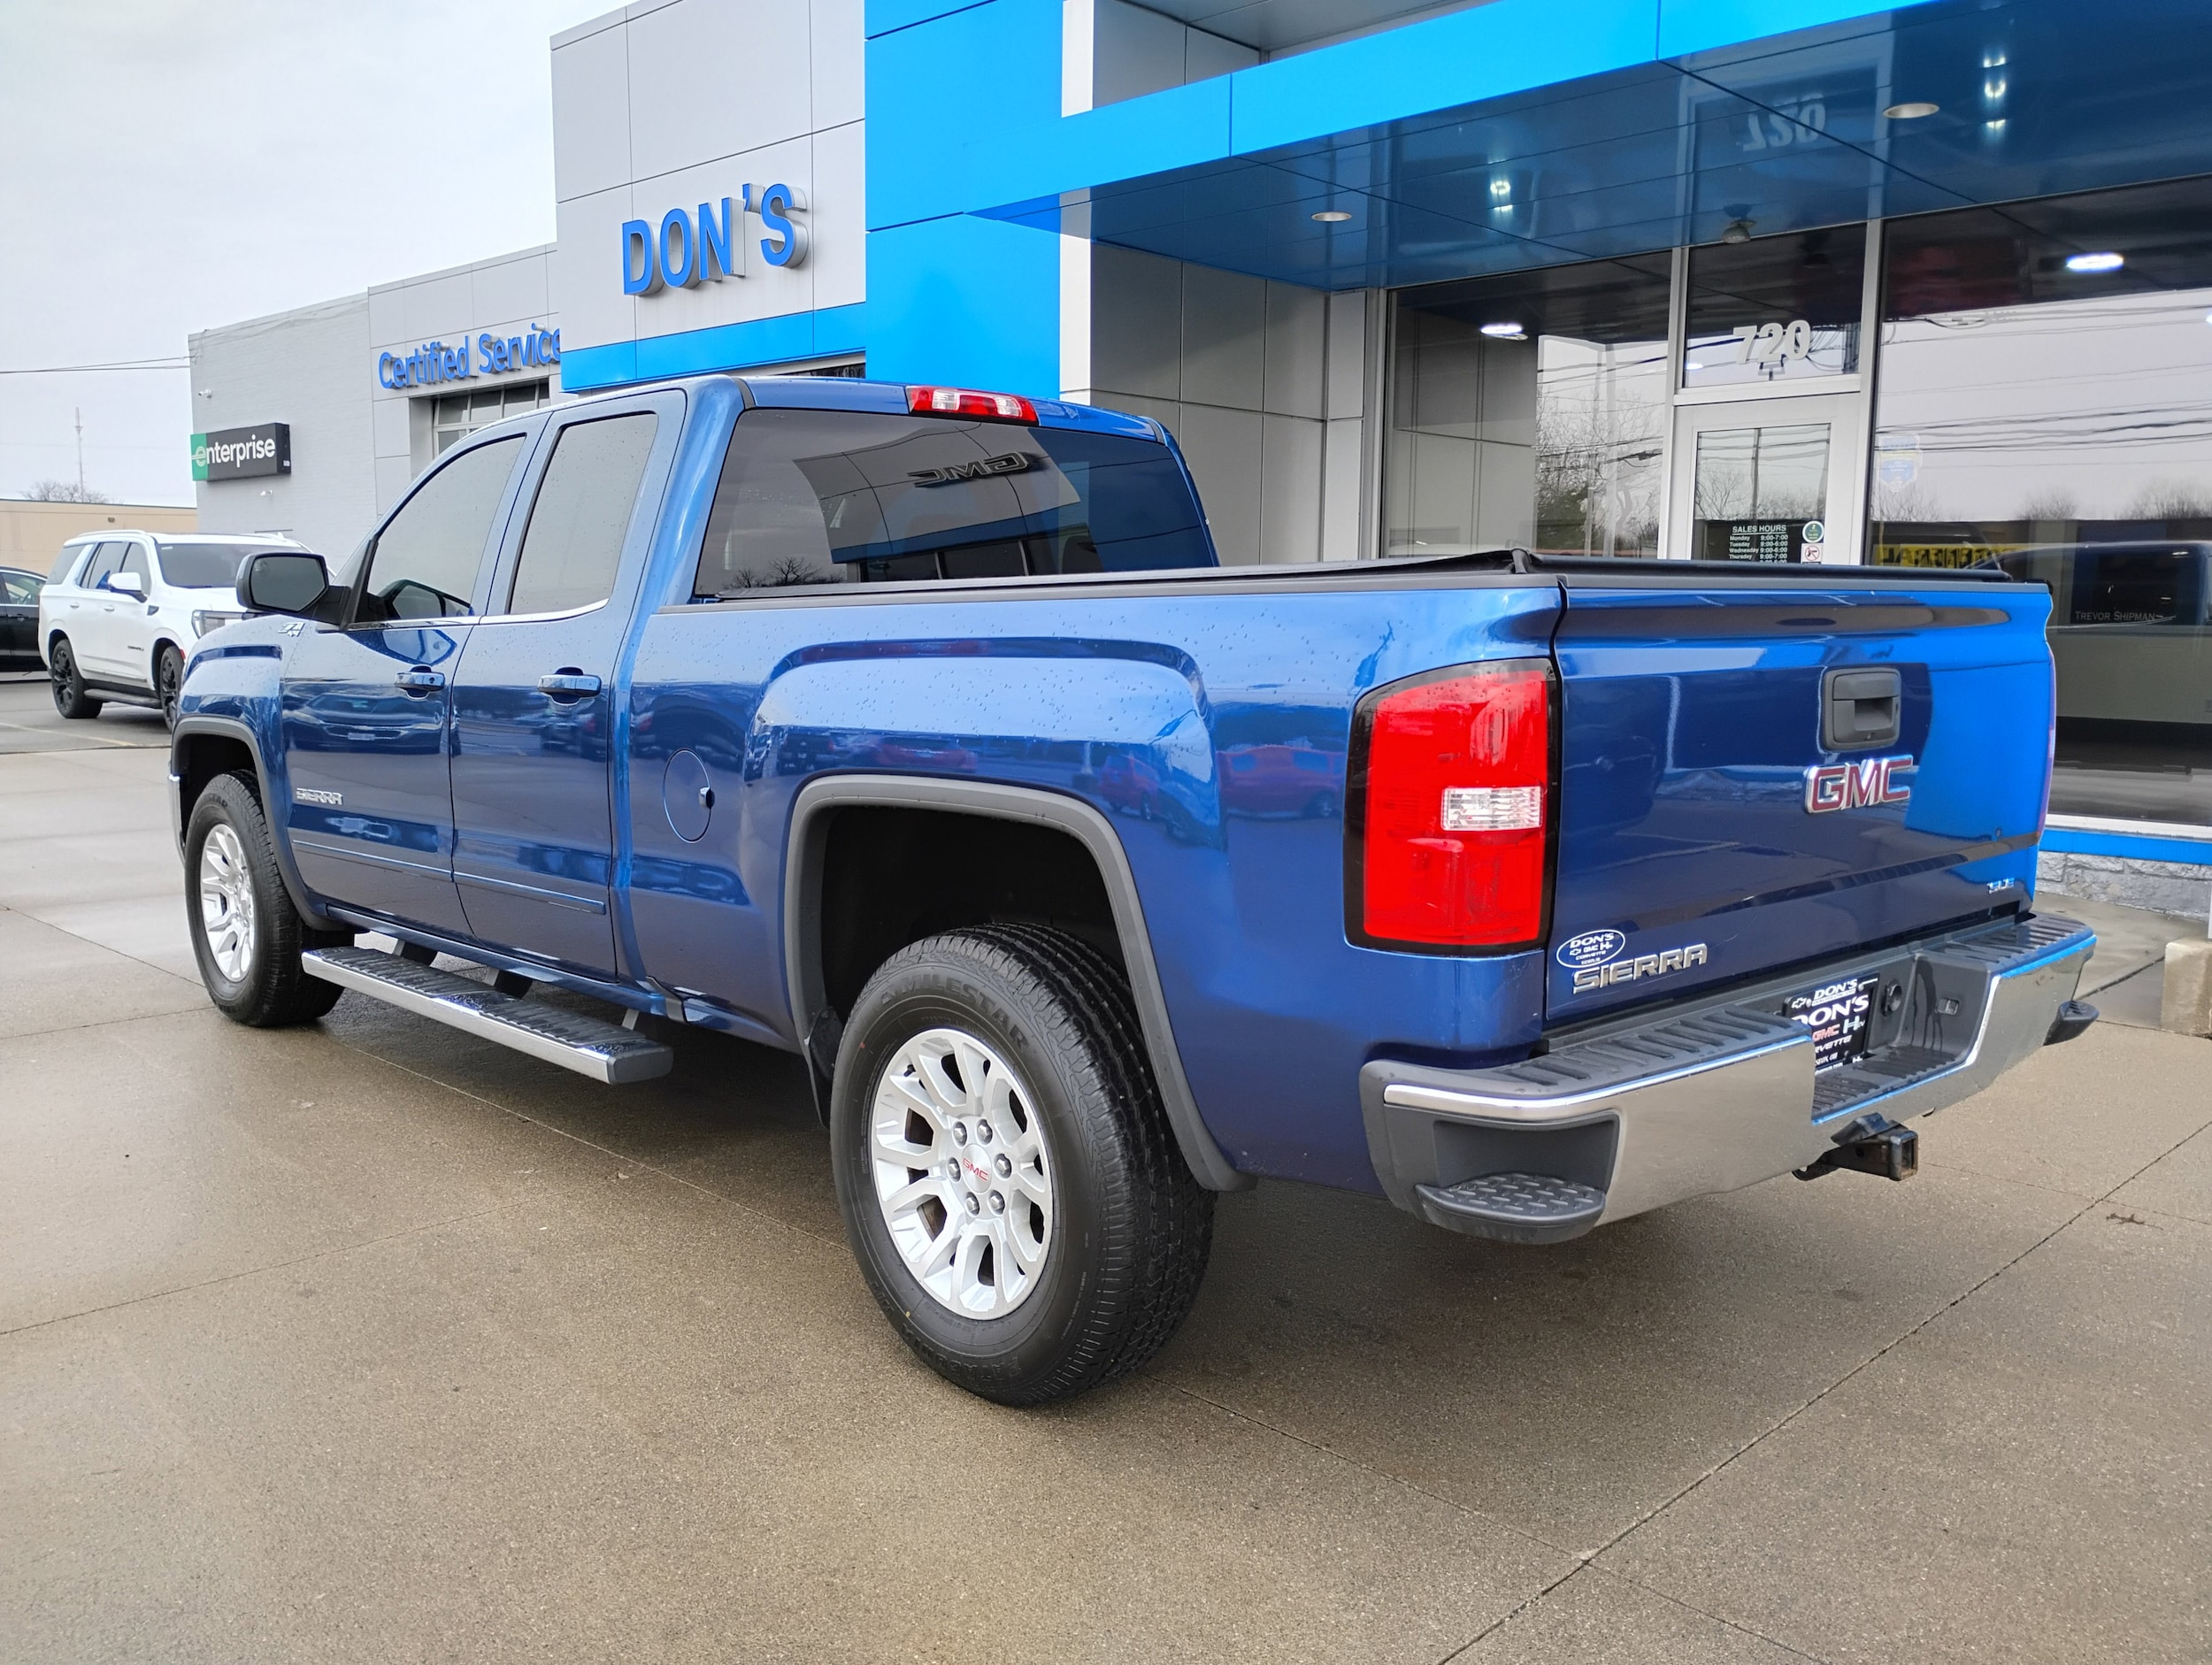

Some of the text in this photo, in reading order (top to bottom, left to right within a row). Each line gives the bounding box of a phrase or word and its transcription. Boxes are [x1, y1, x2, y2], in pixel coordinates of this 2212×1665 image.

[622, 183, 799, 295] DON'S
[1733, 320, 1811, 364] 720
[379, 335, 470, 389] Certified
[191, 434, 276, 468] enterprise
[2075, 611, 2155, 621] TREVOR SHIPMAN
[296, 788, 342, 805] SIERRA
[1803, 755, 1913, 814] GMC
[1570, 932, 1614, 948] DON'S
[1572, 943, 1708, 994] SIERRA
[1814, 978, 1857, 1000] DON'S
[902, 974, 1029, 1050] MILESTAR
[1812, 1024, 1840, 1041] GMC
[1815, 1035, 1852, 1053] RVETTE
[963, 1158, 988, 1181] GMC
